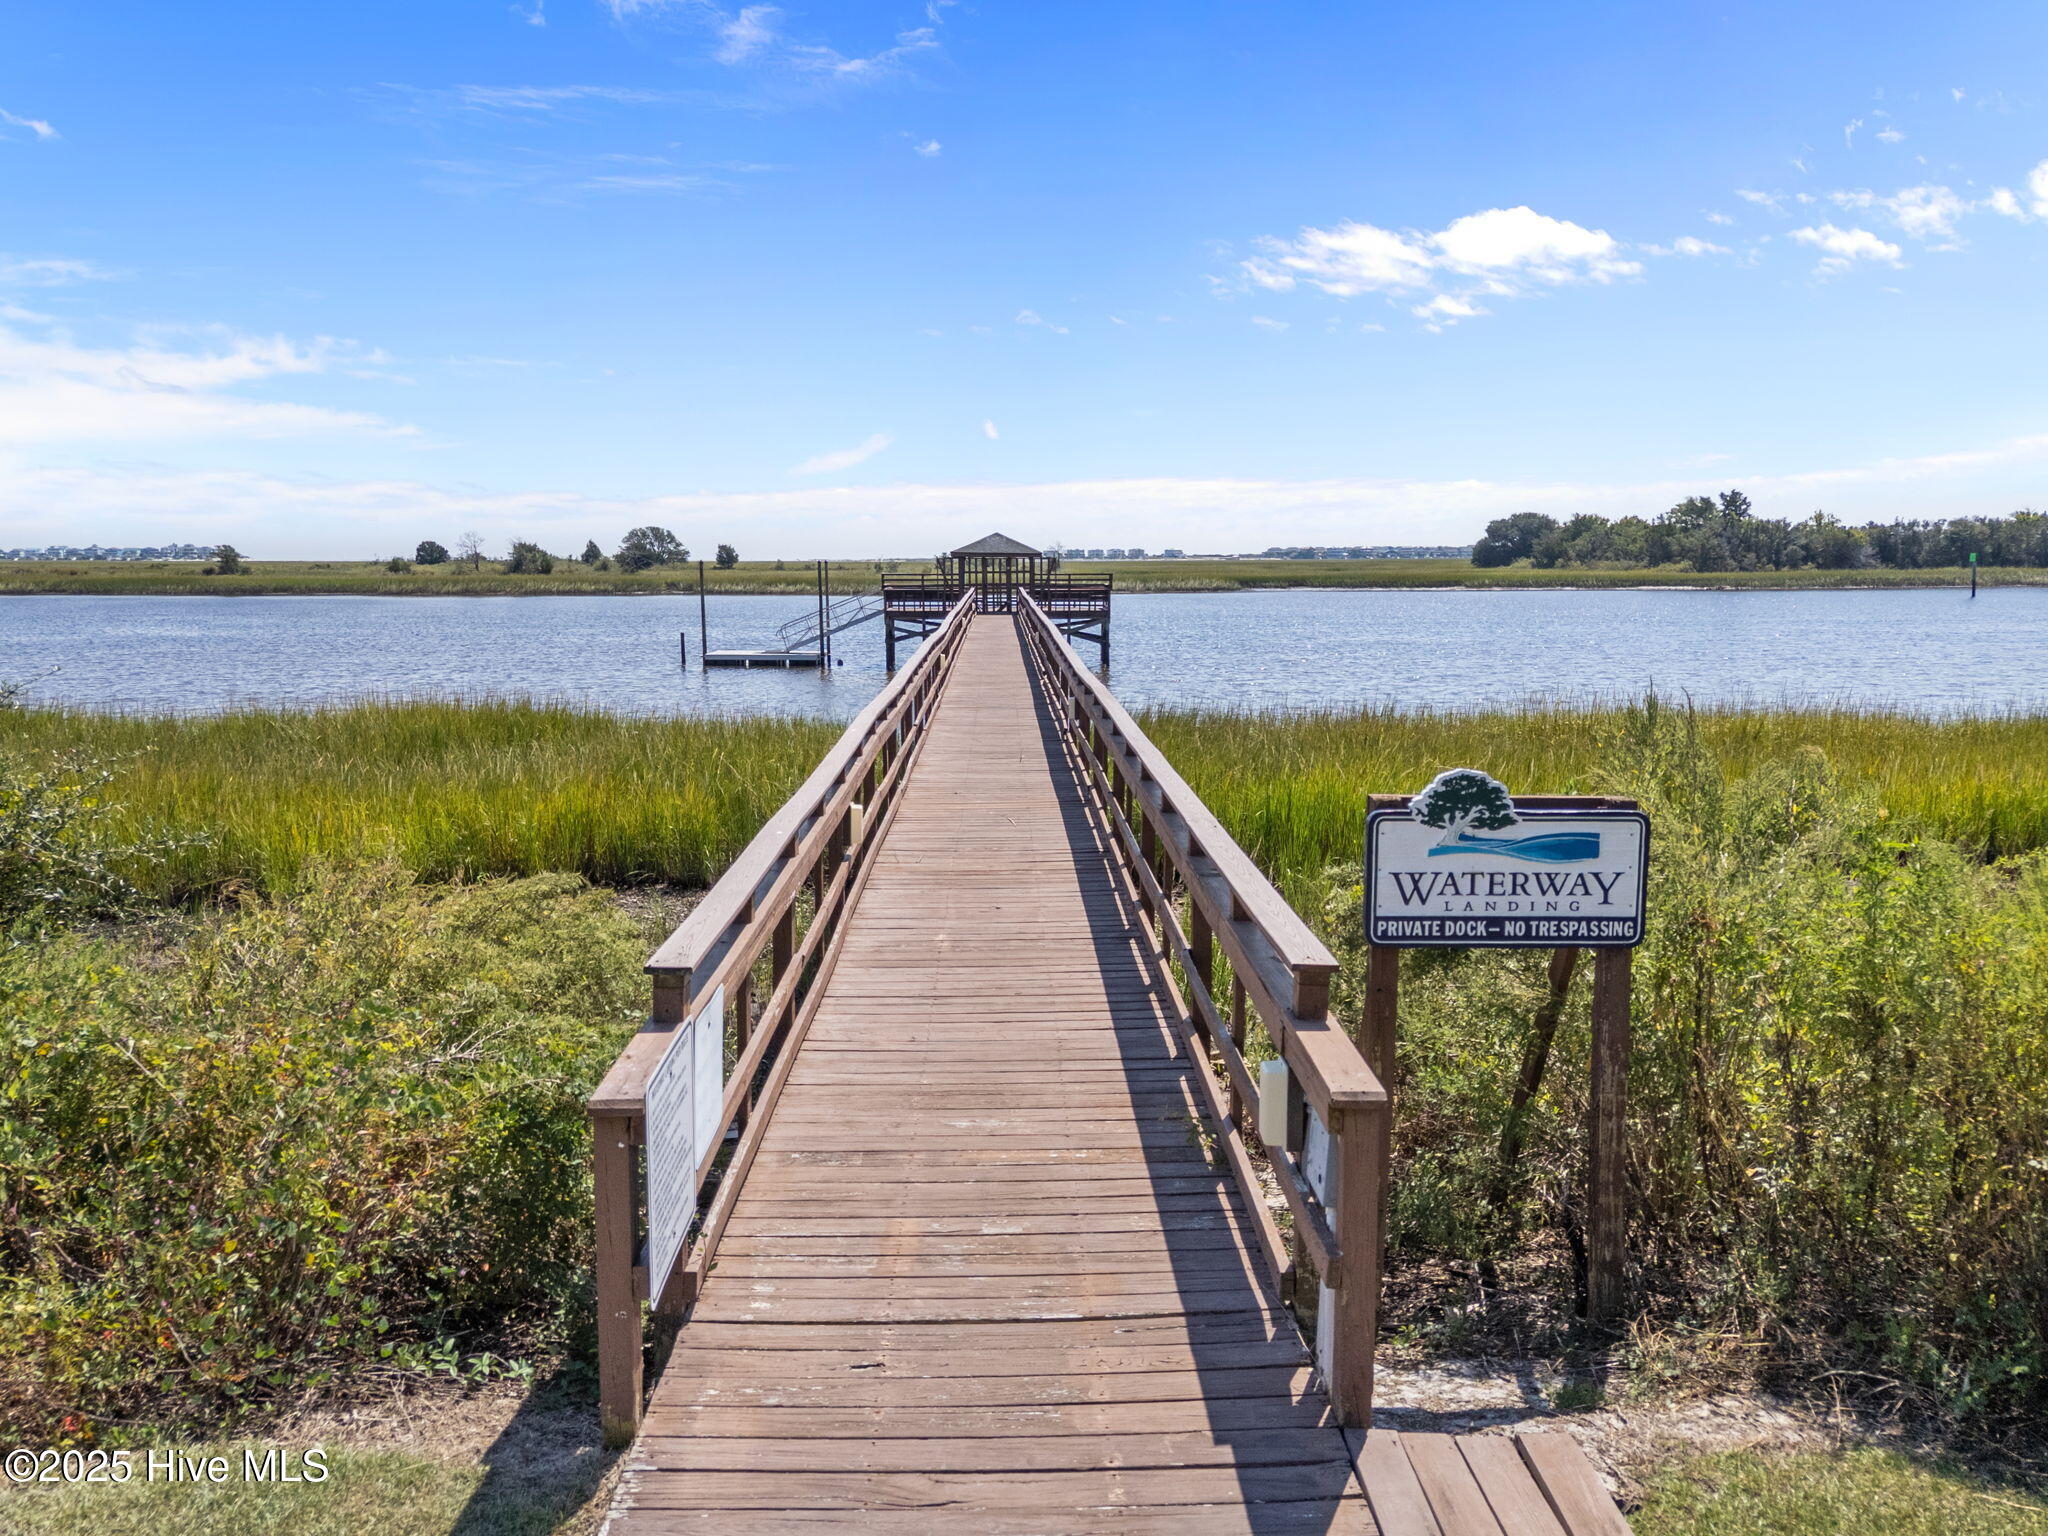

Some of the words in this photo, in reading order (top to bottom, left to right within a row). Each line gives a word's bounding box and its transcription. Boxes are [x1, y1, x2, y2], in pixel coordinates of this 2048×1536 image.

[1388, 871, 1625, 906] WATERWAY
[1444, 901, 1581, 912] LANDING
[1377, 920, 1441, 937] PRIVATE
[1504, 920, 1526, 937] NO
[1529, 920, 1635, 937] TRESPASSING
